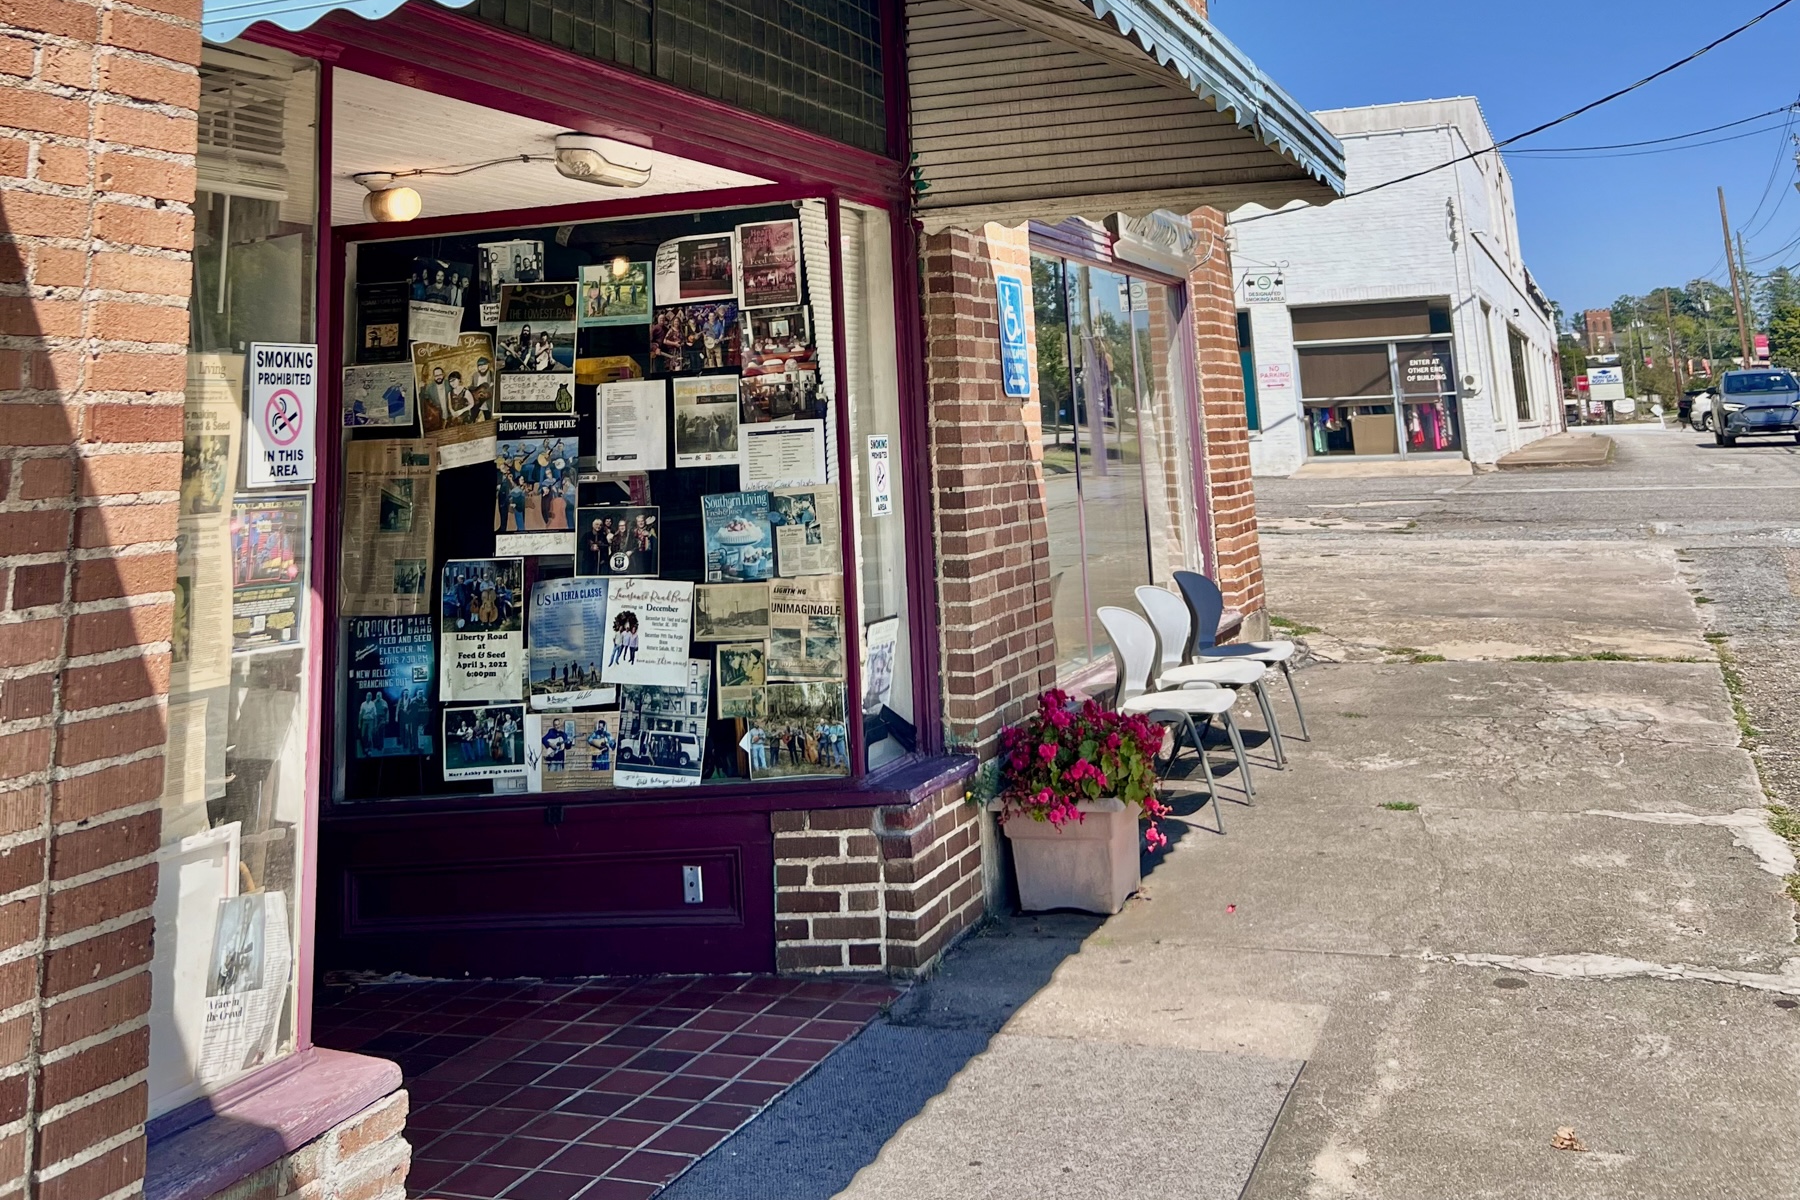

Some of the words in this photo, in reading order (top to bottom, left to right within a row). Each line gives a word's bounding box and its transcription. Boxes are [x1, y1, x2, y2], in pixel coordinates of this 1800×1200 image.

[750, 256, 767, 265] Feed
[775, 255, 793, 263] Seed
[509, 309, 522, 320] THE
[524, 309, 554, 320] LOWEST
[556, 308, 576, 319] PAIR
[464, 336, 487, 348] Band
[256, 350, 314, 369] SMOKING
[1409, 358, 1431, 367] ENTER
[1431, 358, 1440, 366] AT
[198, 361, 227, 378] Living
[1269, 365, 1280, 373] NO
[1407, 366, 1429, 374] OTHER
[1430, 366, 1444, 374] END
[257, 372, 312, 386] PROHIBITED
[190, 410, 217, 421] making
[187, 421, 203, 431] Feed
[205, 421, 211, 431] &
[213, 420, 230, 431] Seed
[538, 419, 577, 430] TURNPIKE
[870, 439, 888, 450] SMOKING
[264, 450, 275, 462] IN
[278, 449, 304, 462] THIS
[269, 464, 299, 477] AREA
[704, 495, 742, 509] Southern
[742, 492, 768, 507] Living
[552, 592, 560, 602] LA
[561, 590, 579, 601] TERZA
[580, 587, 602, 599] CLASSE
[773, 586, 807, 595] LIGHTNNG
[646, 603, 679, 613] December
[771, 602, 841, 616] UNIMAGINABLE
[357, 618, 403, 638] CROOKED
[407, 616, 432, 626] PINE
[407, 625, 432, 635] BAND
[379, 636, 397, 645] FEED
[398, 635, 412, 644] AND
[413, 634, 432, 642] SEED
[456, 633, 485, 642] Liberty
[486, 632, 508, 640] Road
[417, 644, 427, 653] NC
[477, 642, 486, 650] at
[458, 651, 477, 660] Feed
[477, 651, 486, 659] &
[486, 650, 506, 659] Seed
[456, 659, 478, 670] April
[356, 669, 371, 679] NEW
[372, 668, 400, 678] RELEASE
[466, 670, 497, 679] 6:00pm
[206, 1011, 218, 1022] the
